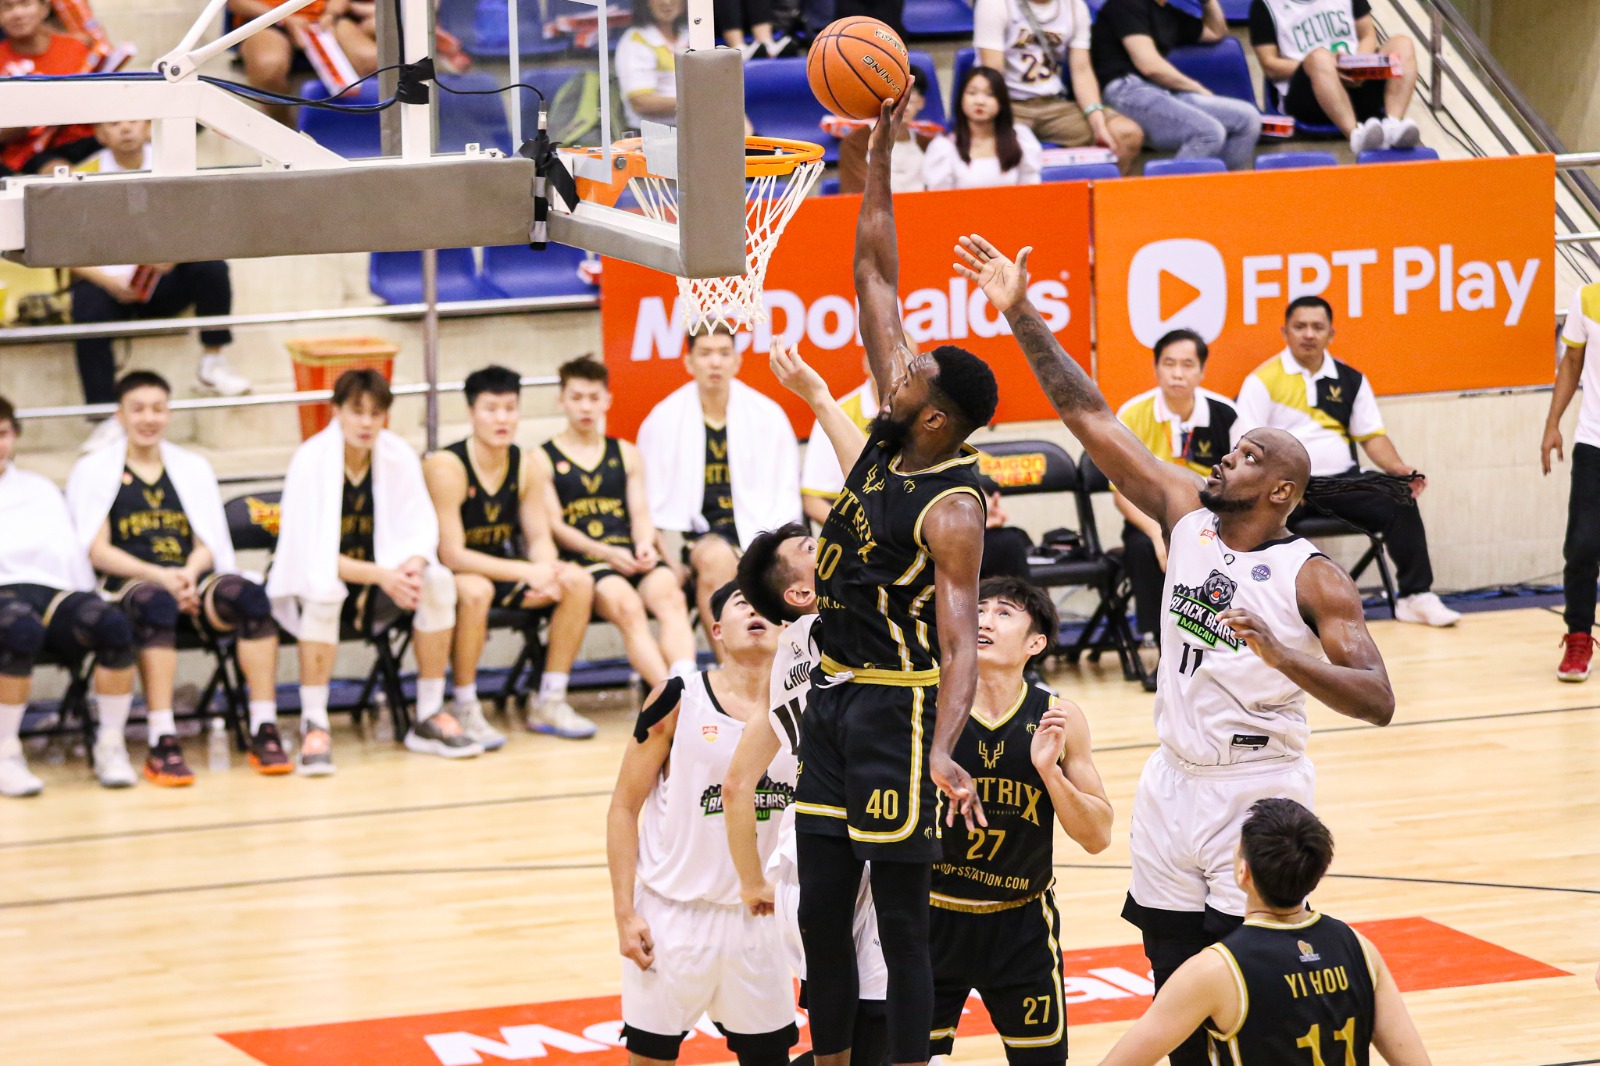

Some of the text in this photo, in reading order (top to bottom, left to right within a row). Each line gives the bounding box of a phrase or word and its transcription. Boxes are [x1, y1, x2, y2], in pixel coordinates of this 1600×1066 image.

[1292, 9, 1352, 53] CELTICS
[1242, 243, 1541, 327] FPT Play
[1170, 595, 1238, 648] BLACK BEARS
[1180, 617, 1216, 643] MACAU
[1178, 642, 1204, 678] 11
[865, 788, 899, 820] 40
[966, 828, 1006, 861] 27
[1283, 966, 1349, 998] YI HOU
[1022, 994, 1051, 1025] 27
[1295, 1016, 1357, 1066] 11
